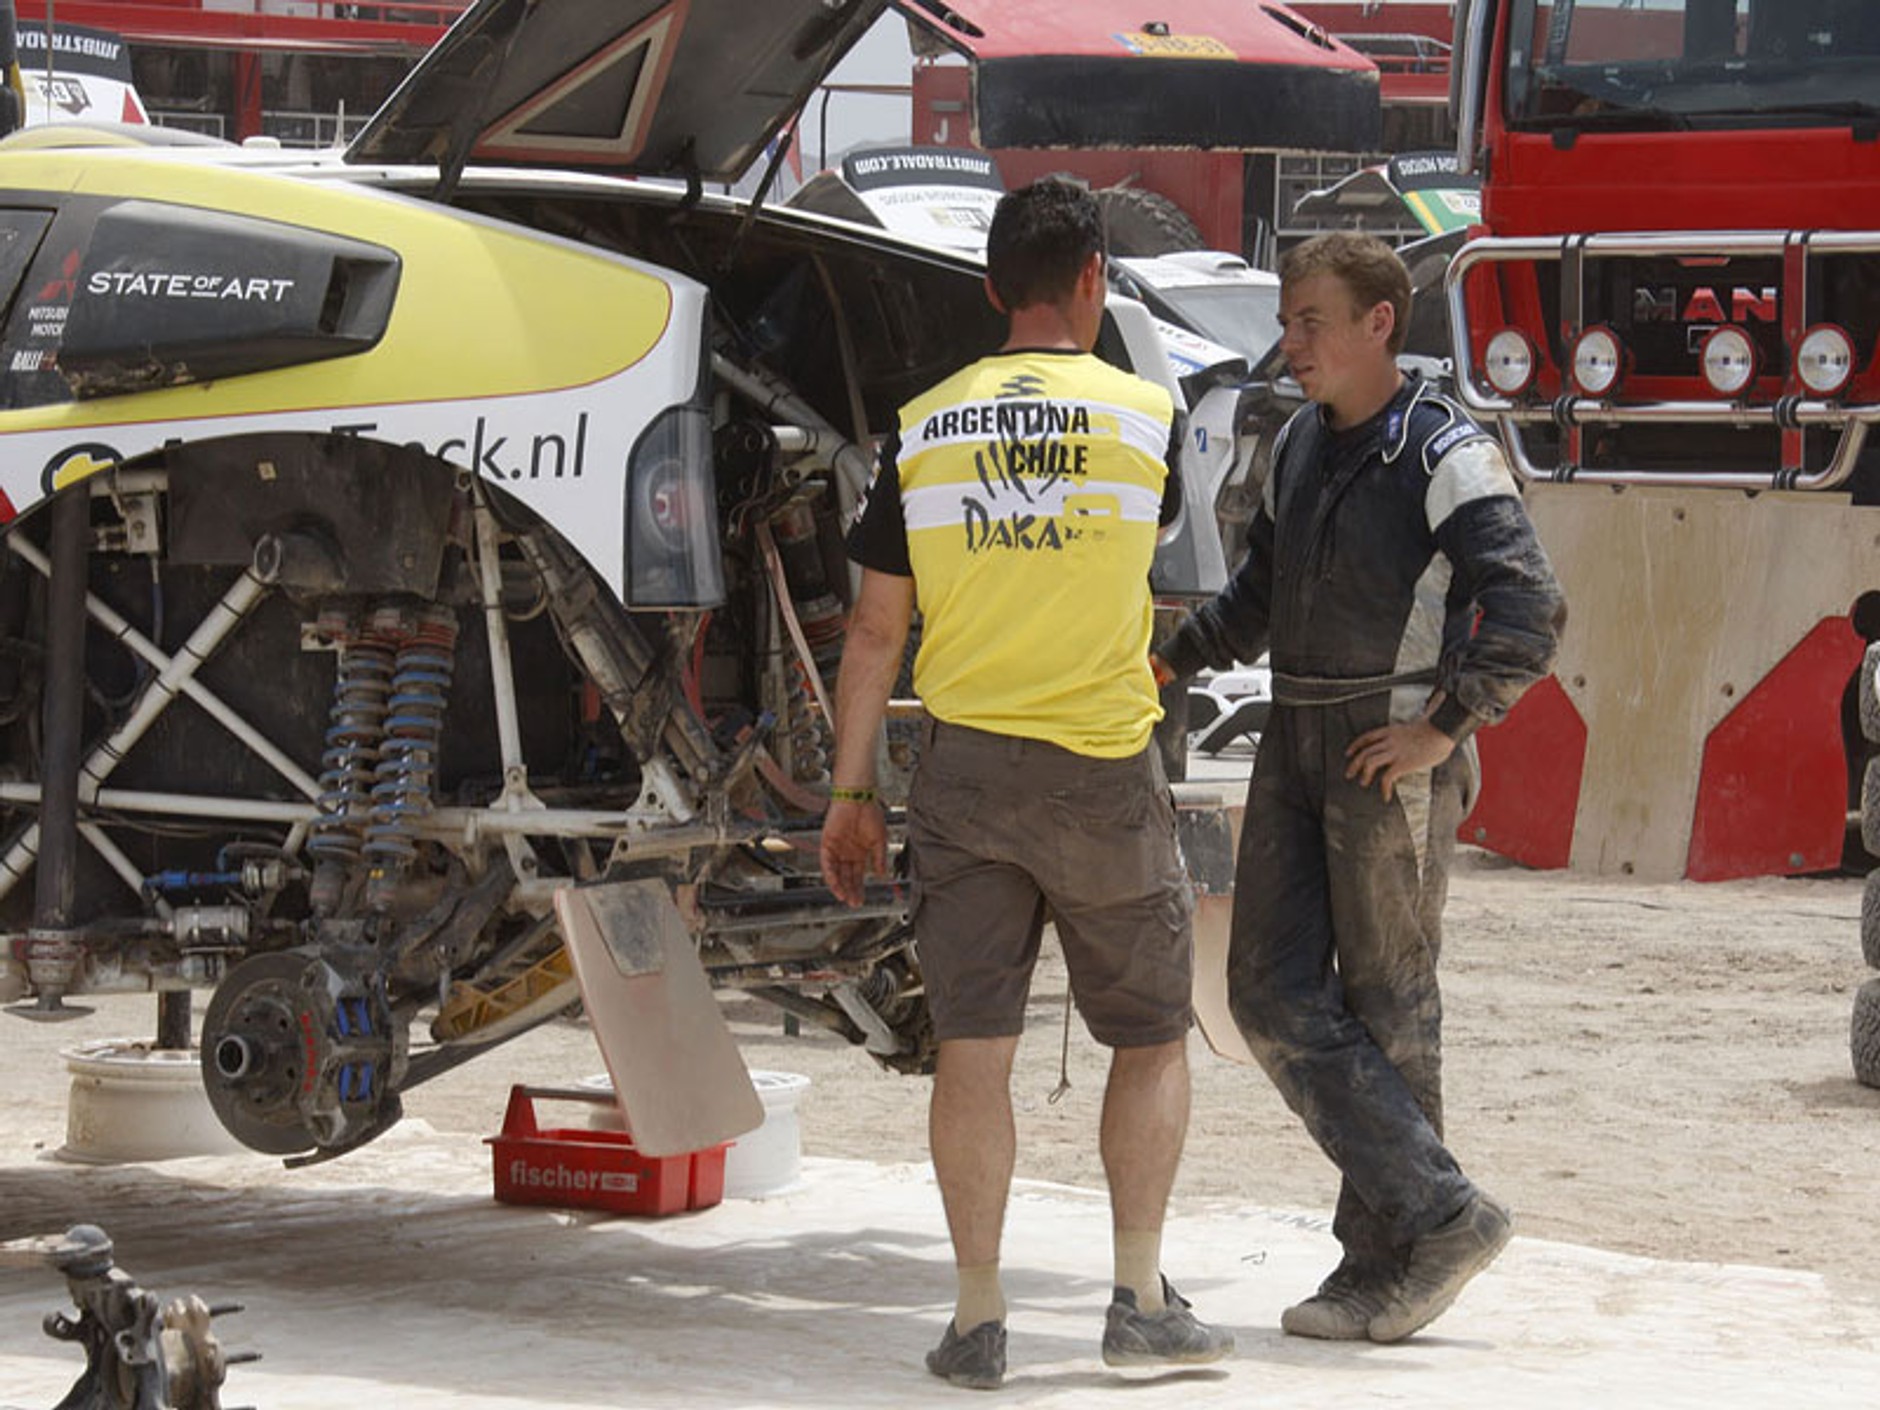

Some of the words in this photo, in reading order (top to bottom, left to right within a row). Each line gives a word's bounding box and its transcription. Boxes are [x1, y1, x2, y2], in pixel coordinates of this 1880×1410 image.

[88, 272, 193, 298] STATE
[191, 275, 223, 298] OF
[220, 278, 294, 301] ART
[1634, 287, 1778, 321] MAN
[923, 405, 1089, 440] ARGENTINA
[1009, 442, 1088, 476] CHILE
[510, 1160, 598, 1190] fischer
